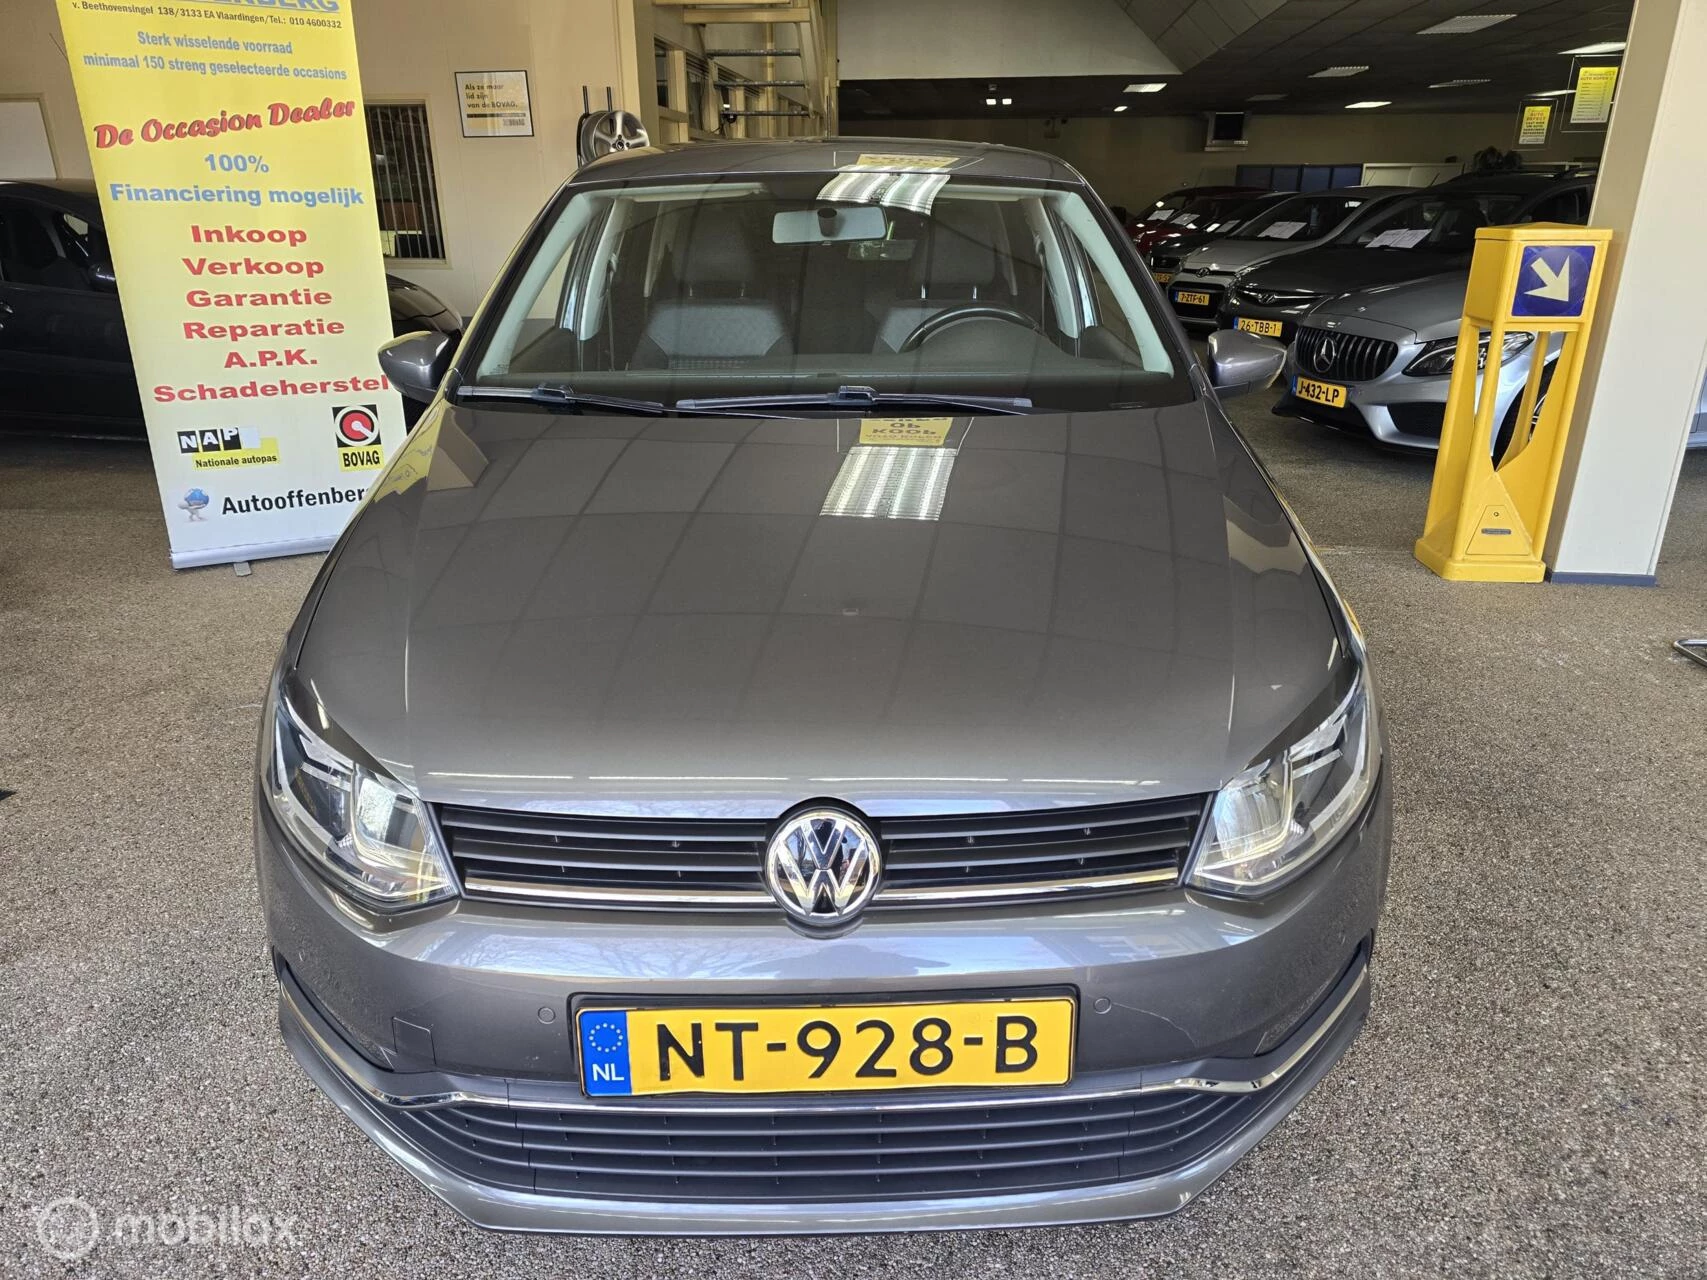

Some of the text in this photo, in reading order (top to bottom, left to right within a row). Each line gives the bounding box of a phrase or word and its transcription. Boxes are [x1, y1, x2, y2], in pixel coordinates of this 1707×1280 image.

[73, 1, 80, 9] v.
[82, 1, 153, 15] Beethovensingel
[158, 6, 202, 18] 138/3133
[204, 10, 215, 18] EA
[289, 17, 305, 25] 010
[306, 18, 342, 29] 4600332
[138, 31, 292, 54] Sterk wisselende voorraad
[83, 53, 347, 80] minimaal 150 streng geselecteerde occasions
[93, 97, 356, 150] De Occasion Dealer
[204, 153, 270, 173] 100%
[109, 183, 364, 208] Financiering mogelijk
[191, 225, 307, 248] Inkoop
[182, 257, 324, 278] Verkoop
[186, 288, 332, 308] Garantie
[183, 318, 345, 341] Reparatie
[224, 348, 317, 369] A.P.K.
[153, 375, 389, 403] Schadeherstel
[1298, 380, 1340, 404] J-432-LP
[179, 427, 240, 450] NAP
[195, 454, 277, 469] Nationale autopas
[342, 450, 380, 467] BOVAG
[222, 487, 369, 515] Autooffenber
[657, 1015, 1038, 1081] NT-928-B
[592, 1063, 625, 1082] NL
